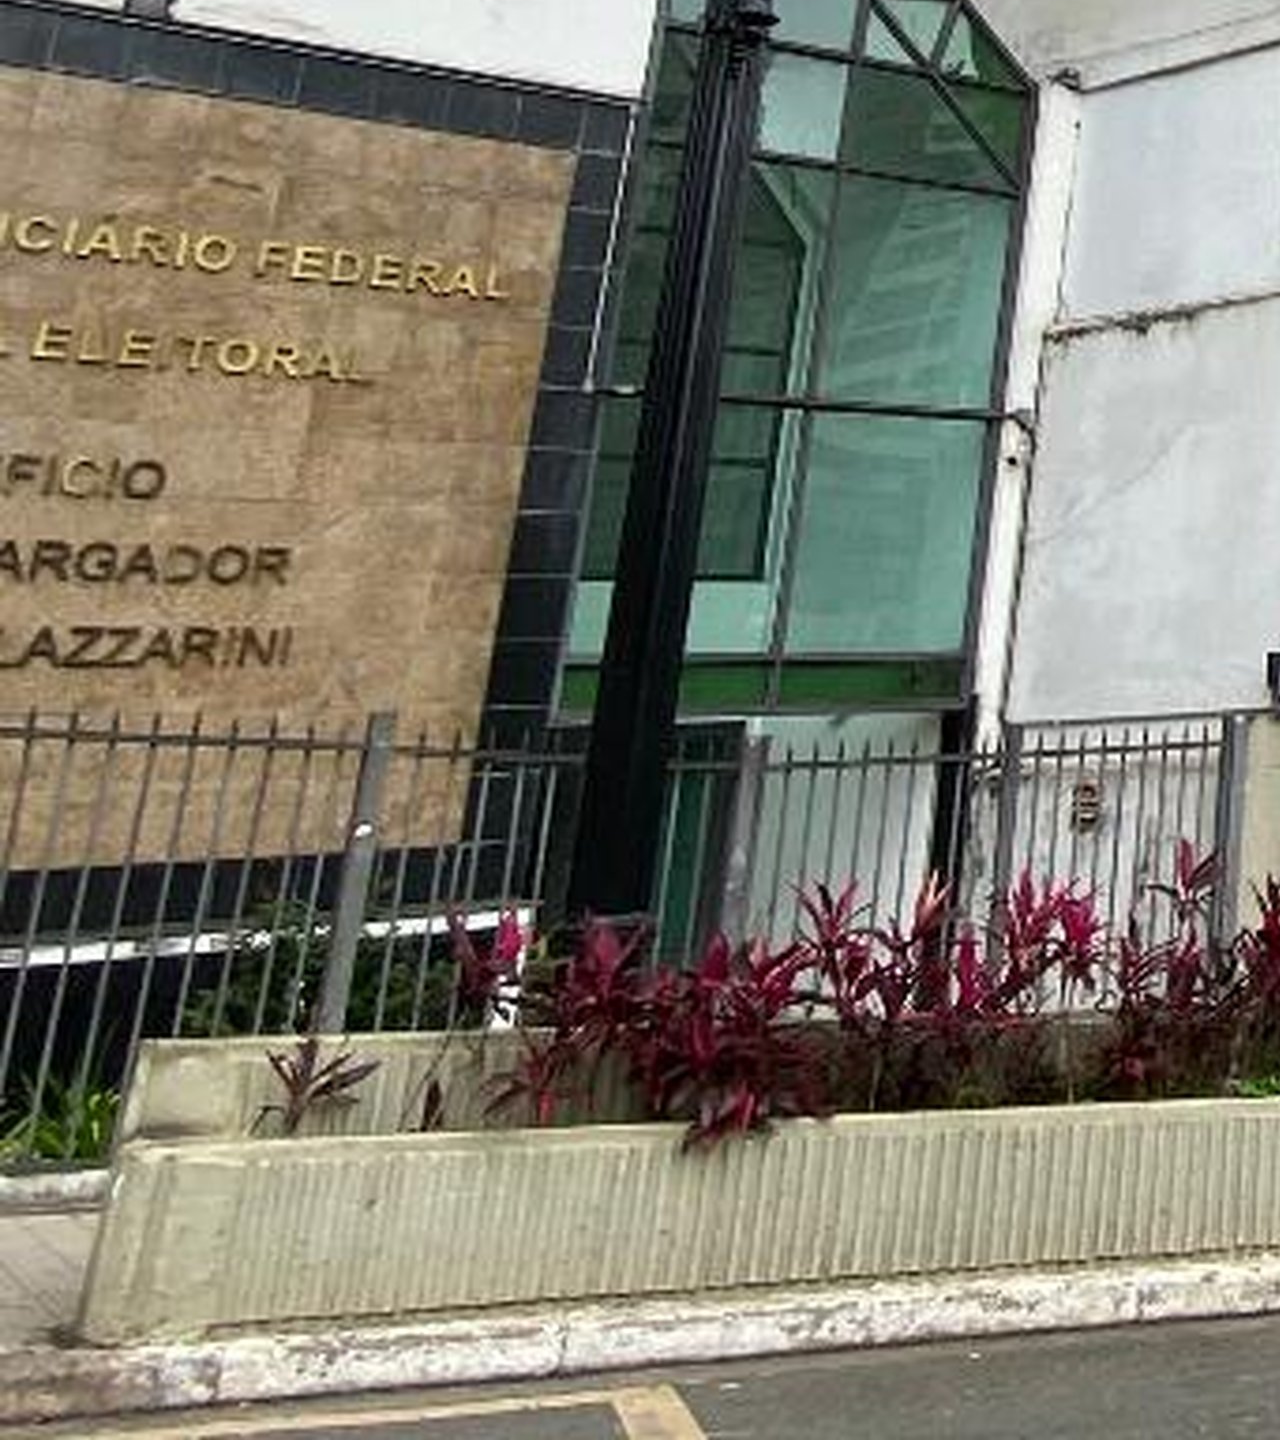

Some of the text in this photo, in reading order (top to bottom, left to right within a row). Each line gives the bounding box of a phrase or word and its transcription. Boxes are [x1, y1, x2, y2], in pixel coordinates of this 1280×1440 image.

[254, 240, 511, 301] FEDERAL
[29, 321, 376, 383] ELEITORAL
[0, 539, 293, 587] ARGADOR
